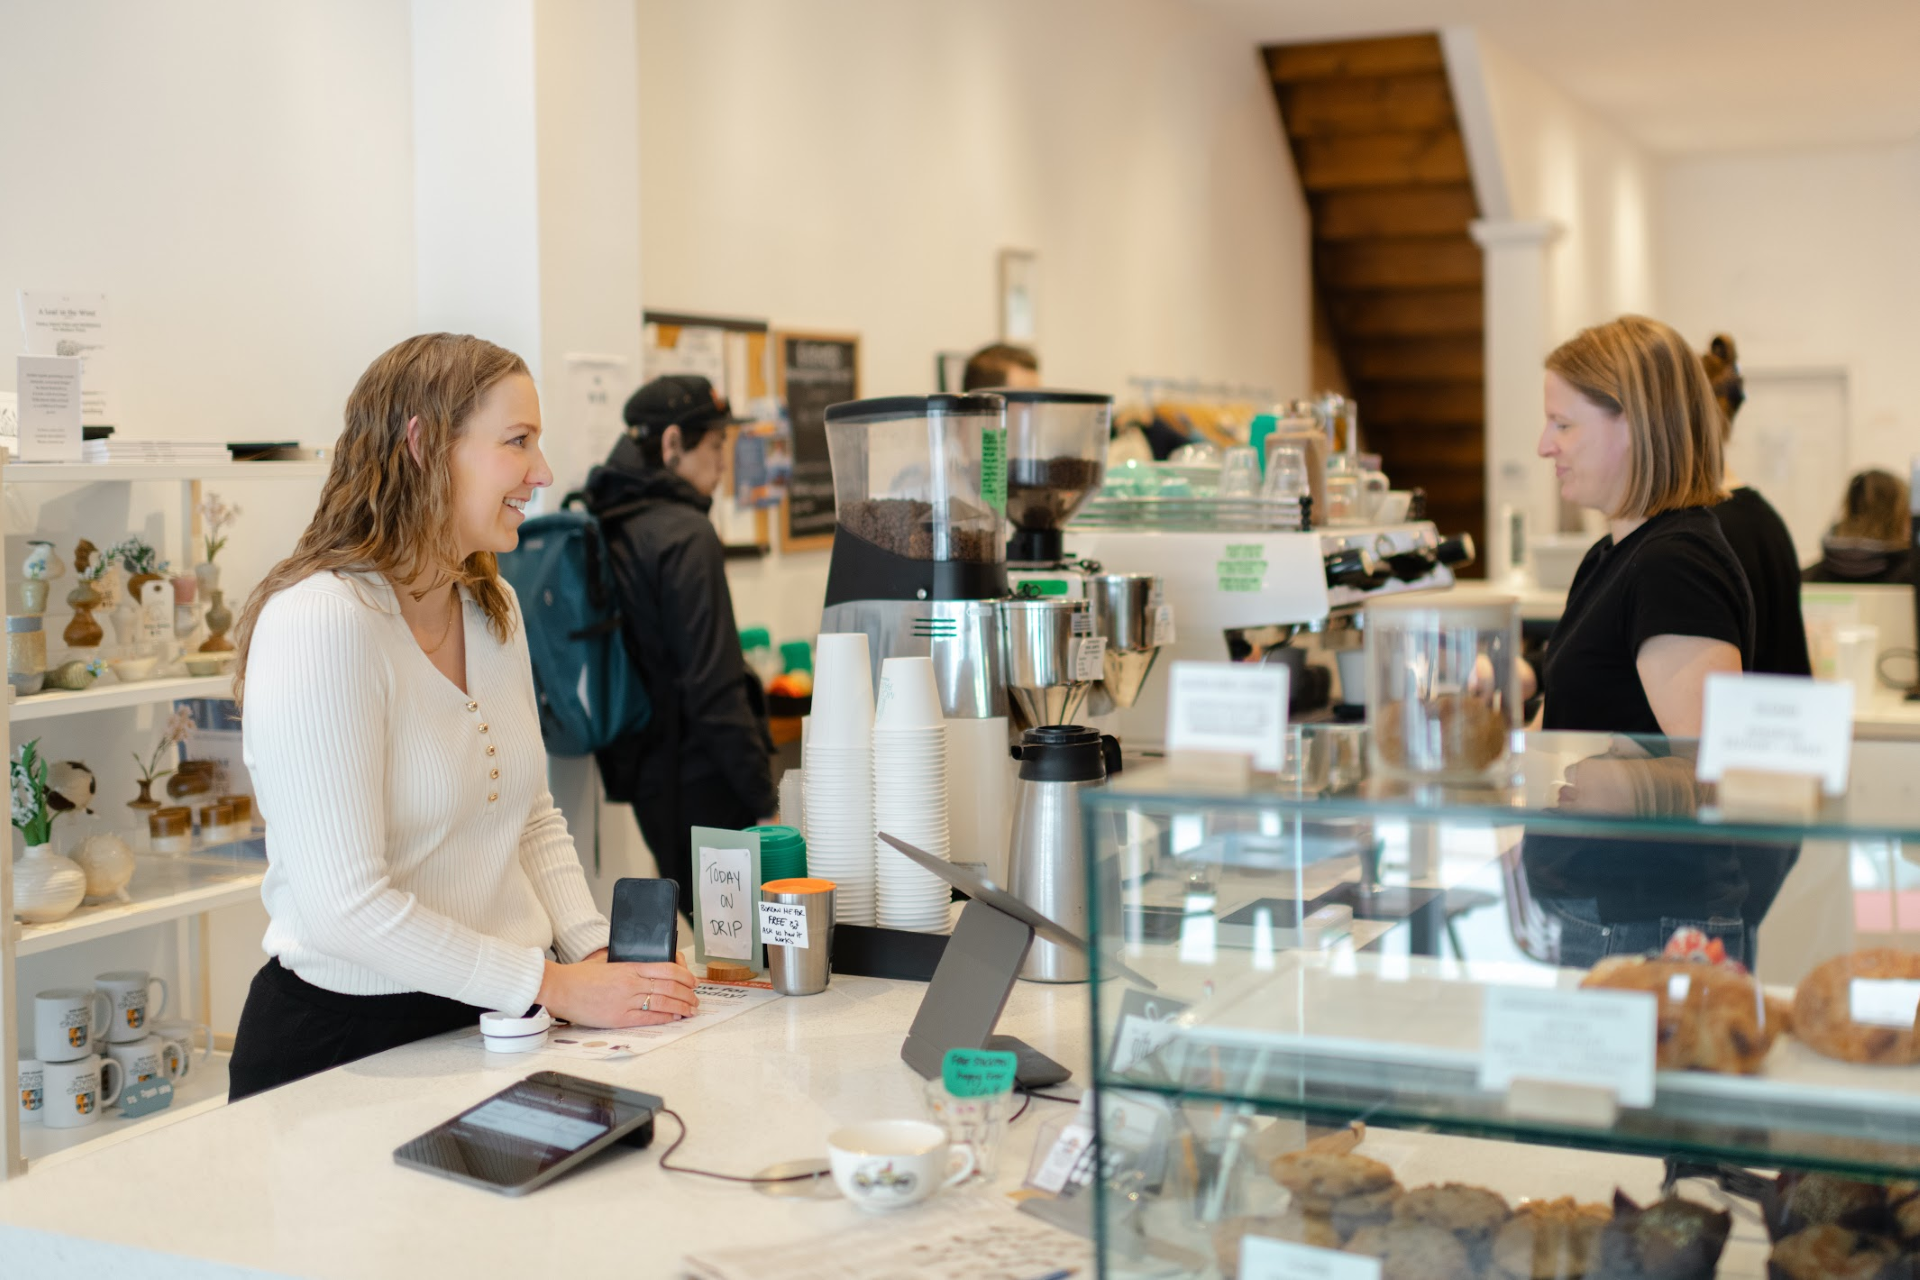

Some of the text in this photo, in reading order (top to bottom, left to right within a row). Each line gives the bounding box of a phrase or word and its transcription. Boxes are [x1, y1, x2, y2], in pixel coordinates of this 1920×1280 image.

[705, 861, 741, 891] TODAY
[720, 893, 734, 909] ON
[710, 919, 743, 938] DRIP
[768, 915, 788, 926] FREE
